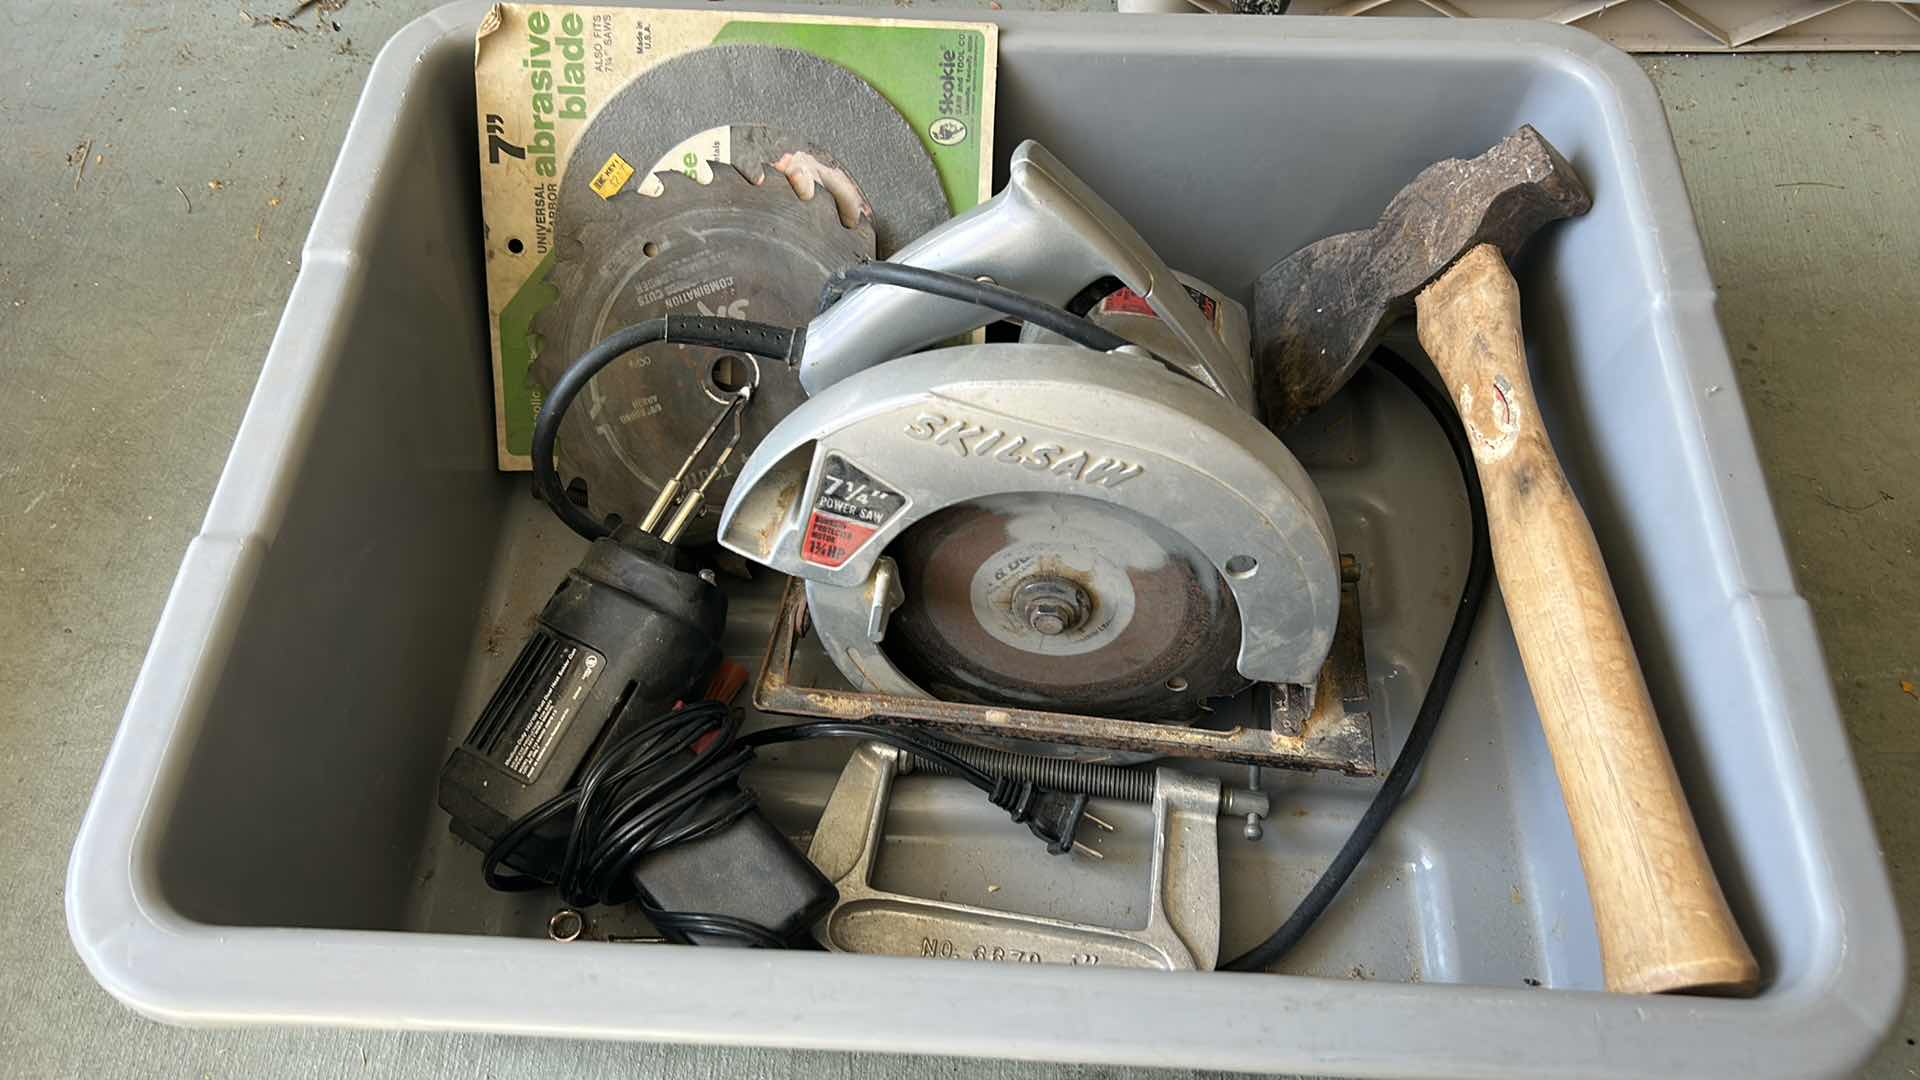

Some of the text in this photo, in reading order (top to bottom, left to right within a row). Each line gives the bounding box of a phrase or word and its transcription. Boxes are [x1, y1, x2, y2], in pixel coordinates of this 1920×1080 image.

[592, 15, 604, 73] ALSO FITS
[602, 15, 613, 47] SAWS
[957, 50, 965, 73] TOOL
[523, 11, 557, 177] abrasive
[554, 12, 588, 119] blade
[938, 49, 956, 114] Skokie
[533, 183, 548, 254] UNIVERSAL
[664, 275, 734, 310] COMBINATION
[903, 411, 1144, 488] SKILSAW
[819, 496, 857, 515] POWER
[859, 508, 885, 523] SAW
